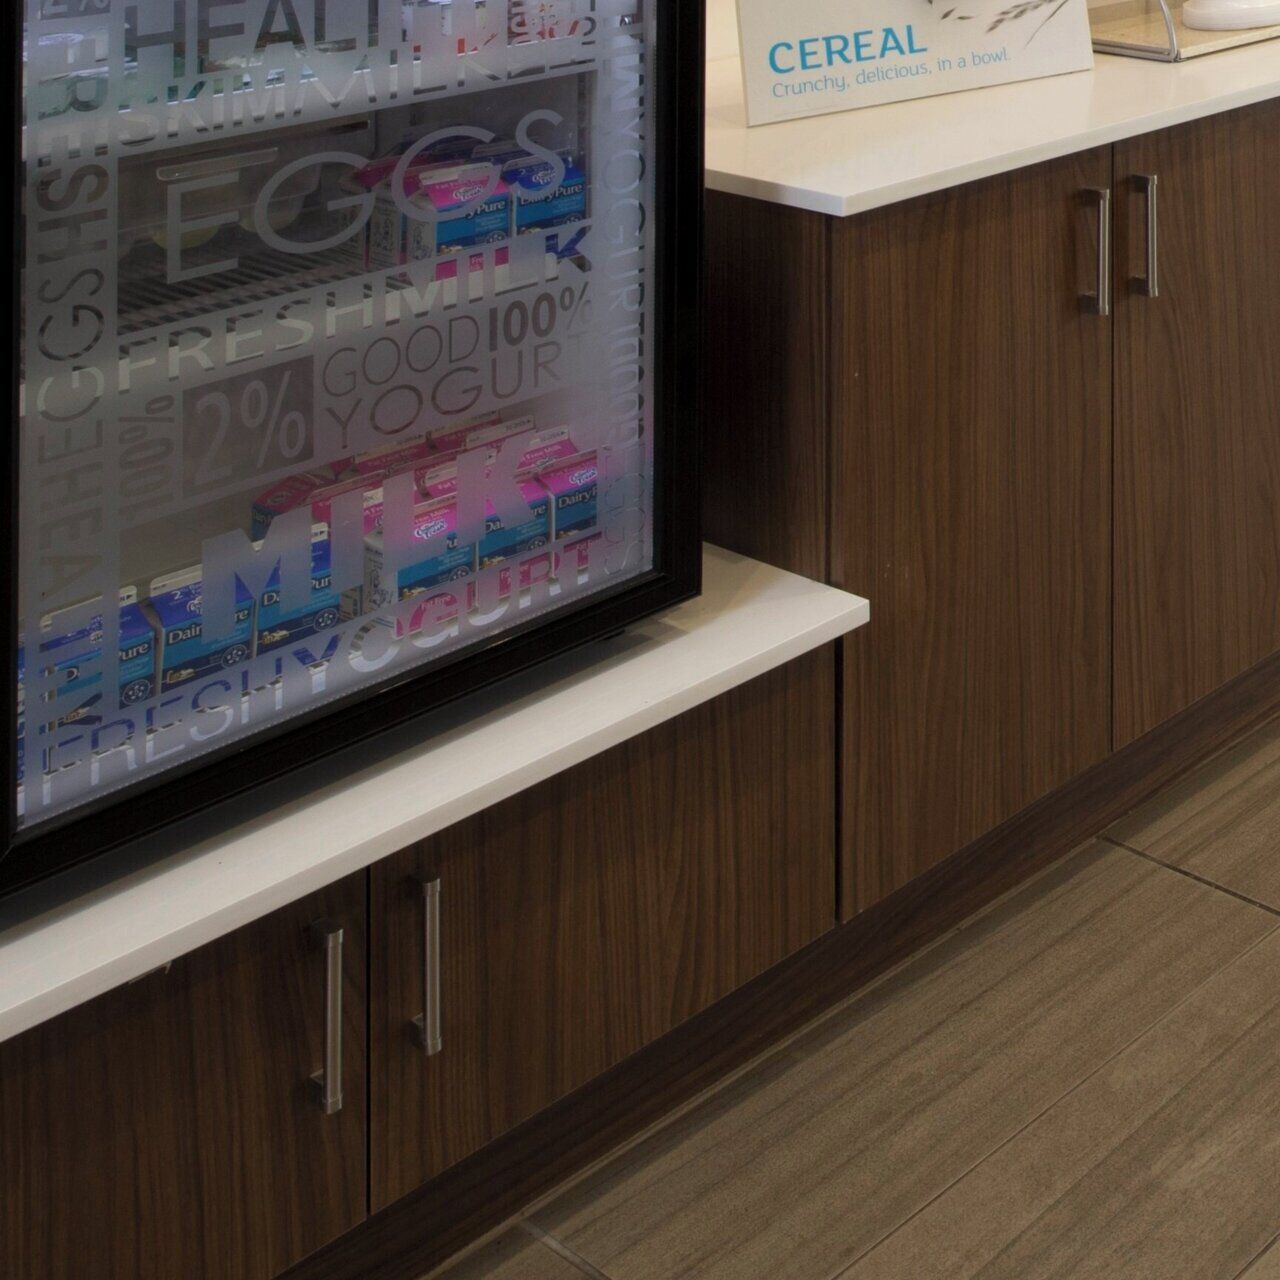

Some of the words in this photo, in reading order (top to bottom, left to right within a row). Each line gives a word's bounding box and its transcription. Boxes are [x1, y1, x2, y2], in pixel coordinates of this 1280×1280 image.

[768, 24, 928, 75] CEREAL
[772, 74, 850, 99] Crunchy,
[855, 62, 932, 87] delicious,
[936, 58, 952, 72] in
[957, 56, 967, 69] a
[971, 46, 1012, 67] bowl.
[165, 108, 566, 284] EGGS
[386, 227, 592, 326] MILK
[489, 281, 593, 351] 100%
[118, 282, 374, 394] FRESH
[322, 314, 480, 398] GOOD
[194, 370, 307, 486] 2%
[202, 438, 540, 645] MILK
[292, 530, 602, 673] YOGURT
[42, 656, 286, 806] FRESH
